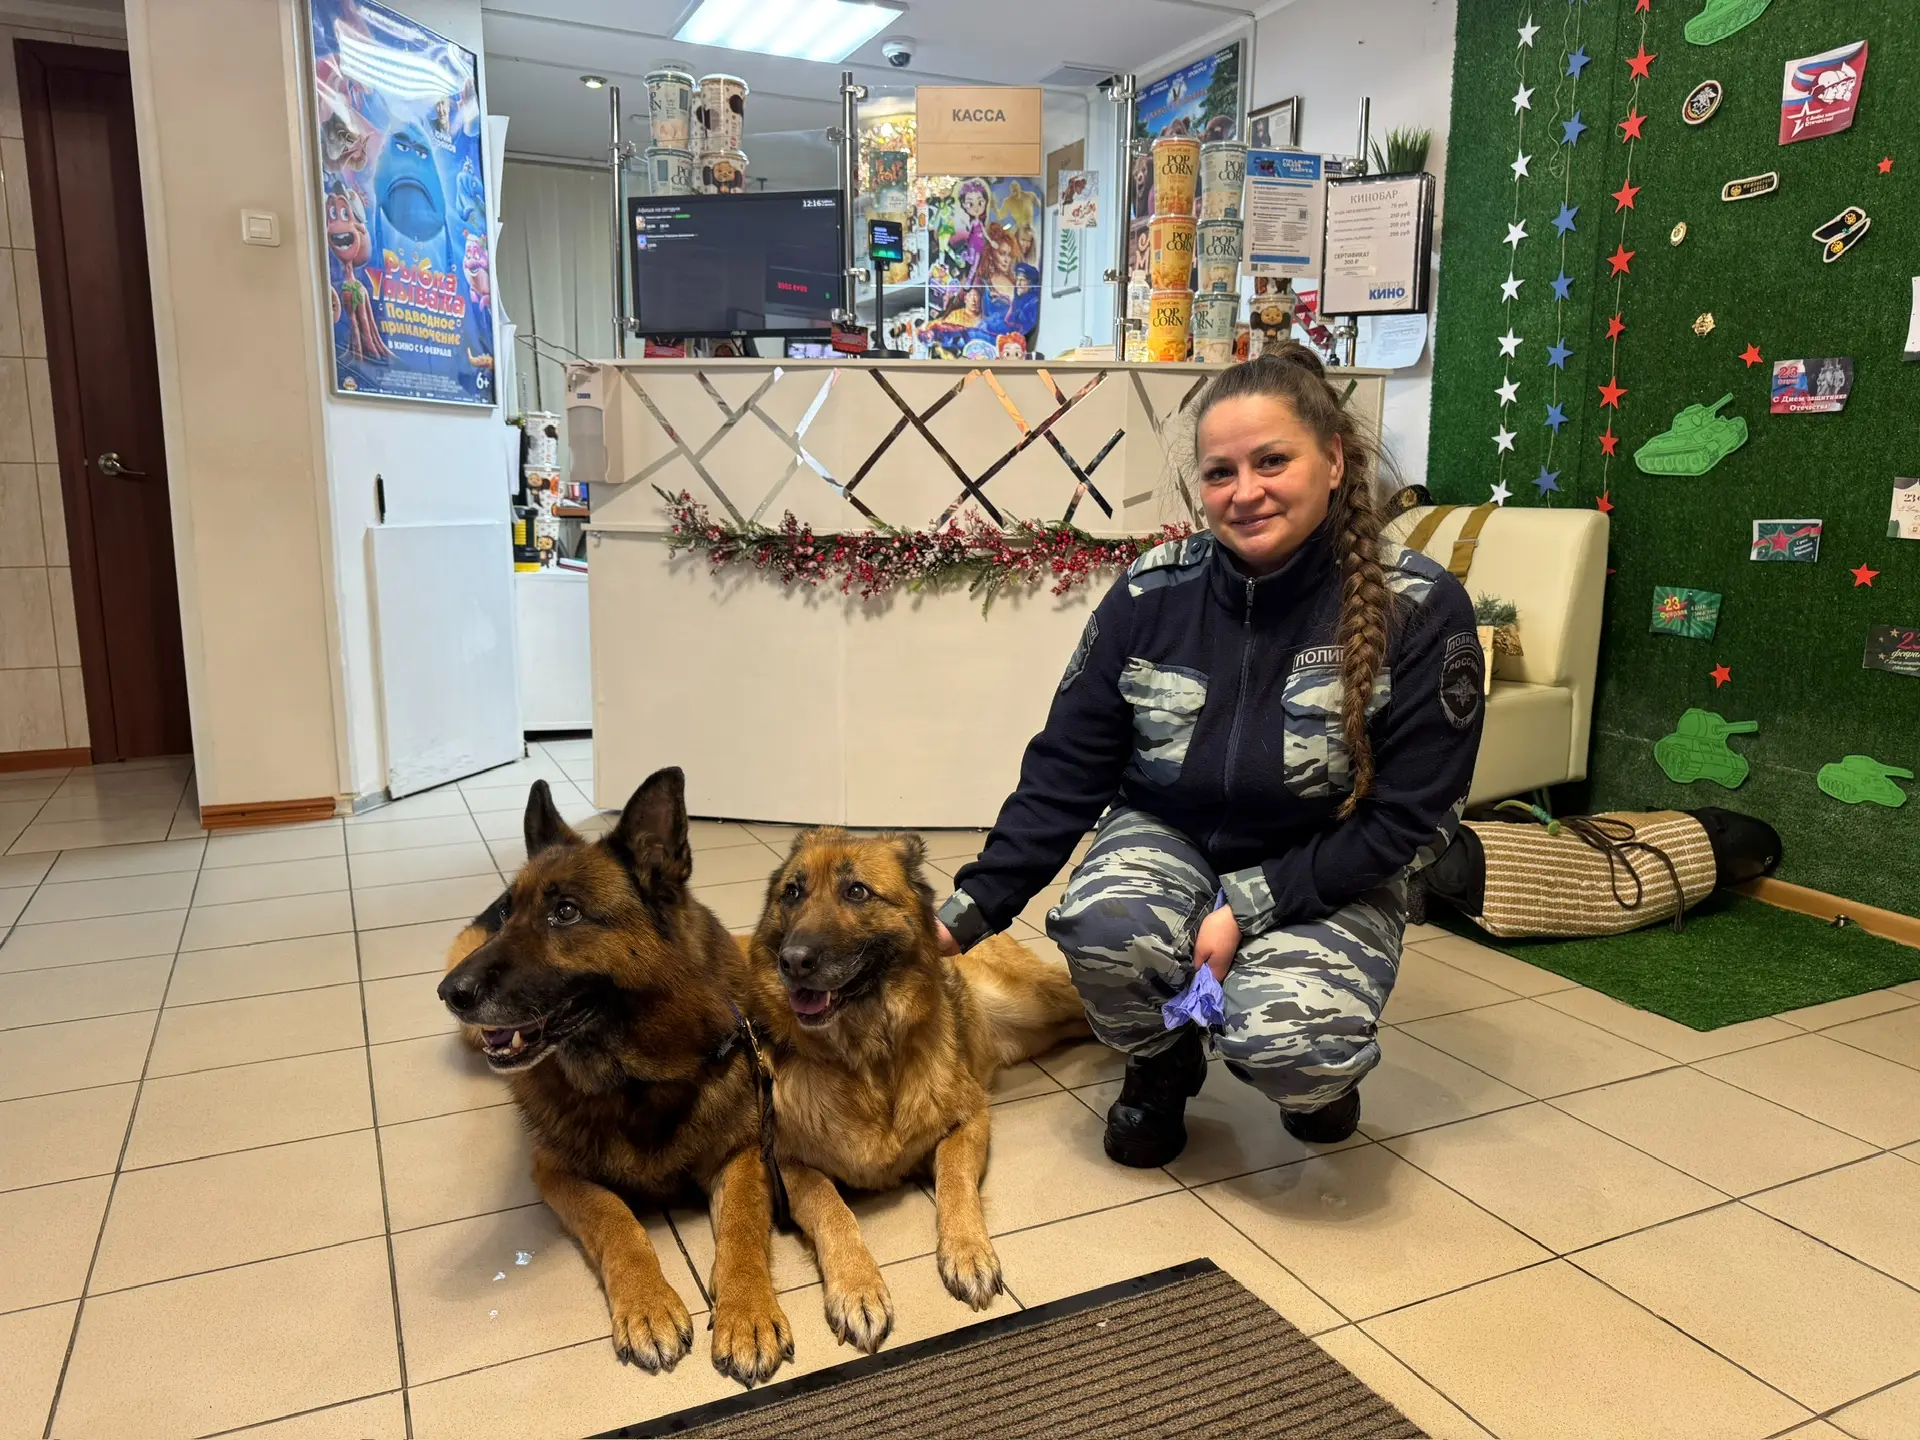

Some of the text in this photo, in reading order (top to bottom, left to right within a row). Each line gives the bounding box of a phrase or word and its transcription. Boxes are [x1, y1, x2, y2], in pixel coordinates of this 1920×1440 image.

[952, 108, 1006, 122] КАССА
[1167, 154, 1190, 165] POP
[1162, 164, 1193, 175] CORN
[1350, 189, 1398, 204] КИНОБАР
[1172, 232, 1192, 242] POP
[1212, 235, 1235, 247] POP
[1206, 244, 1237, 256] CORN
[1368, 287, 1406, 300] КИНО
[1157, 307, 1180, 318] POP
[1152, 316, 1184, 327] CORN
[394, 341, 414, 352] КИНО
[424, 345, 452, 357] ФЕВРАЛЯ
[1778, 366, 1798, 379] 23
[476, 372, 490, 389] 6+
[1807, 394, 1848, 402] защитника
[1904, 493, 1916, 503] 23
[1664, 596, 1680, 610] 23
